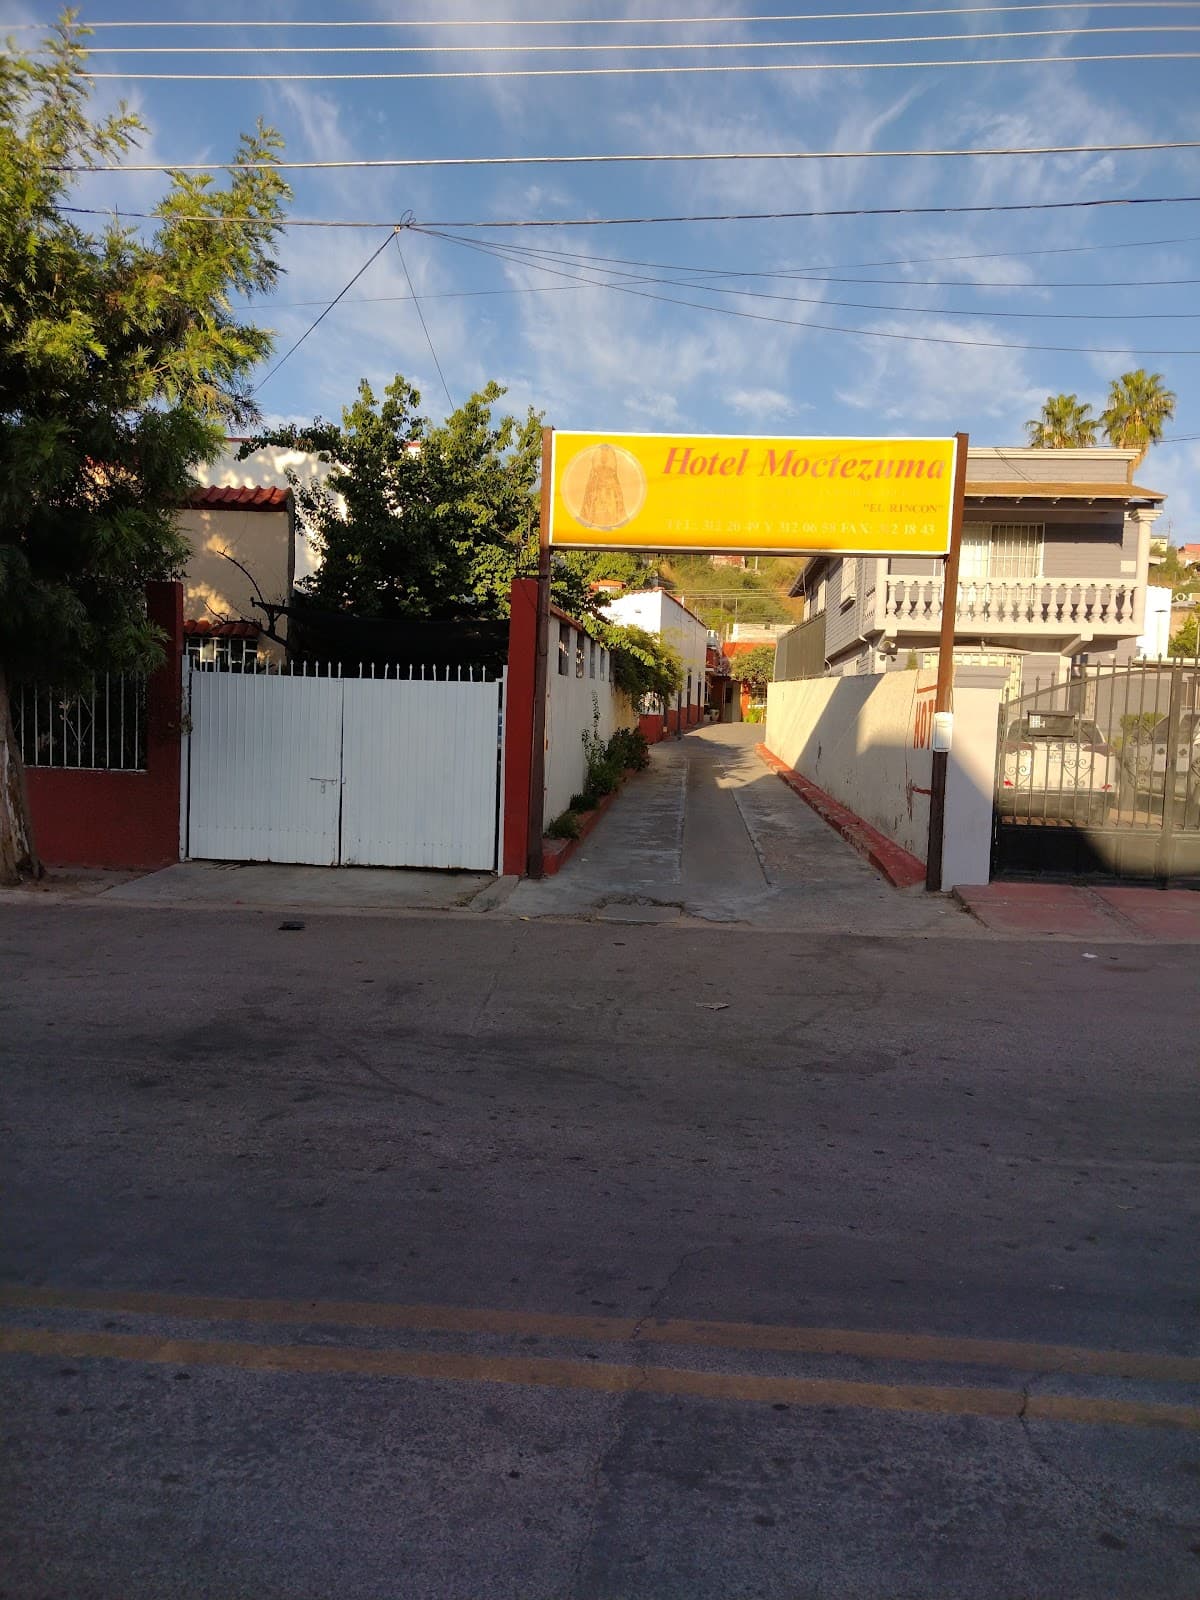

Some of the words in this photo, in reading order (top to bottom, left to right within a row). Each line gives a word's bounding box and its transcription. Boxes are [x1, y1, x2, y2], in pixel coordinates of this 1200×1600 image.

[662, 447, 750, 477] Hotel
[758, 448, 946, 482] Moctezuma
[913, 699, 936, 750] HOT
